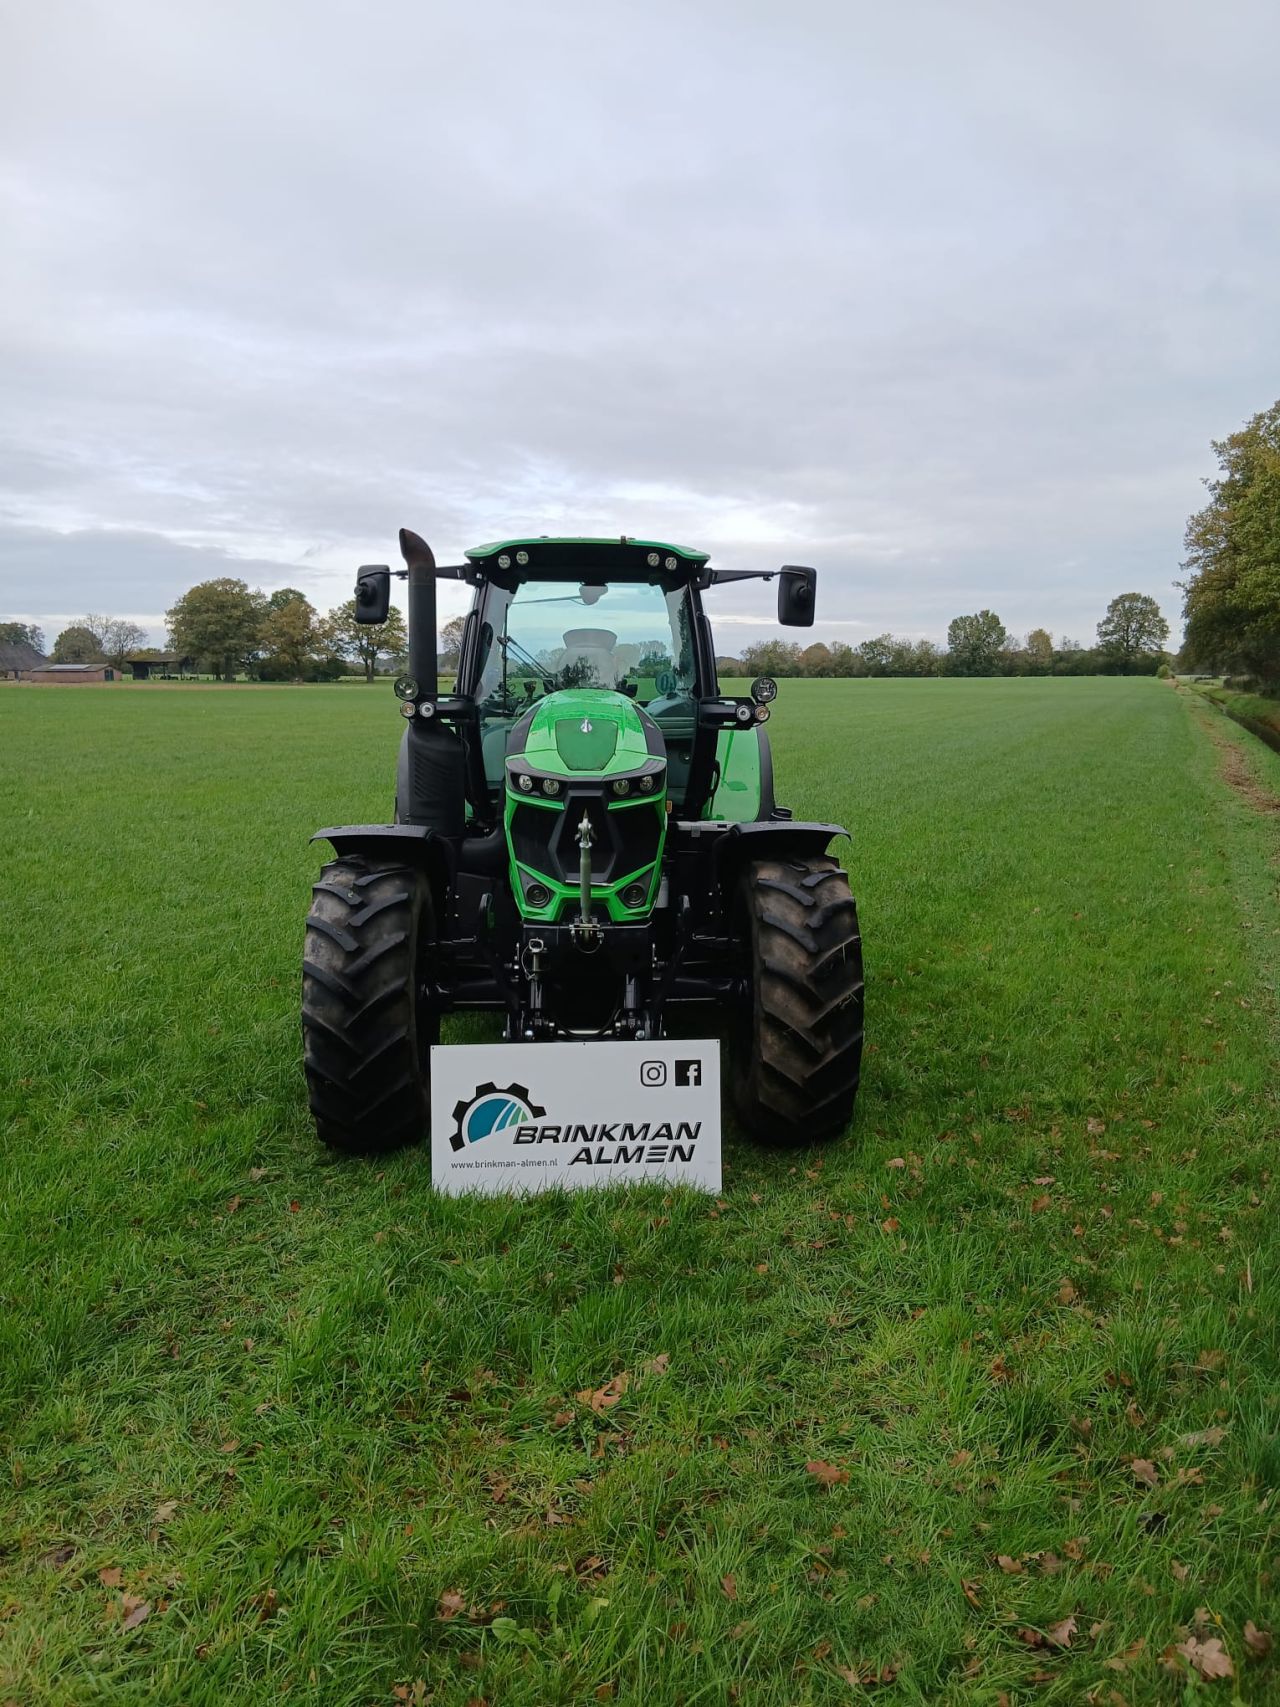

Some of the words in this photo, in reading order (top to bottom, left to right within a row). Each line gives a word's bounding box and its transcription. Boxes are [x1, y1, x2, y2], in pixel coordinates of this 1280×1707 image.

[513, 1122, 701, 1144] BRINKMAN
[451, 1158, 558, 1169] www.brinkman-almen.nl
[567, 1145, 695, 1165] ALMEN
